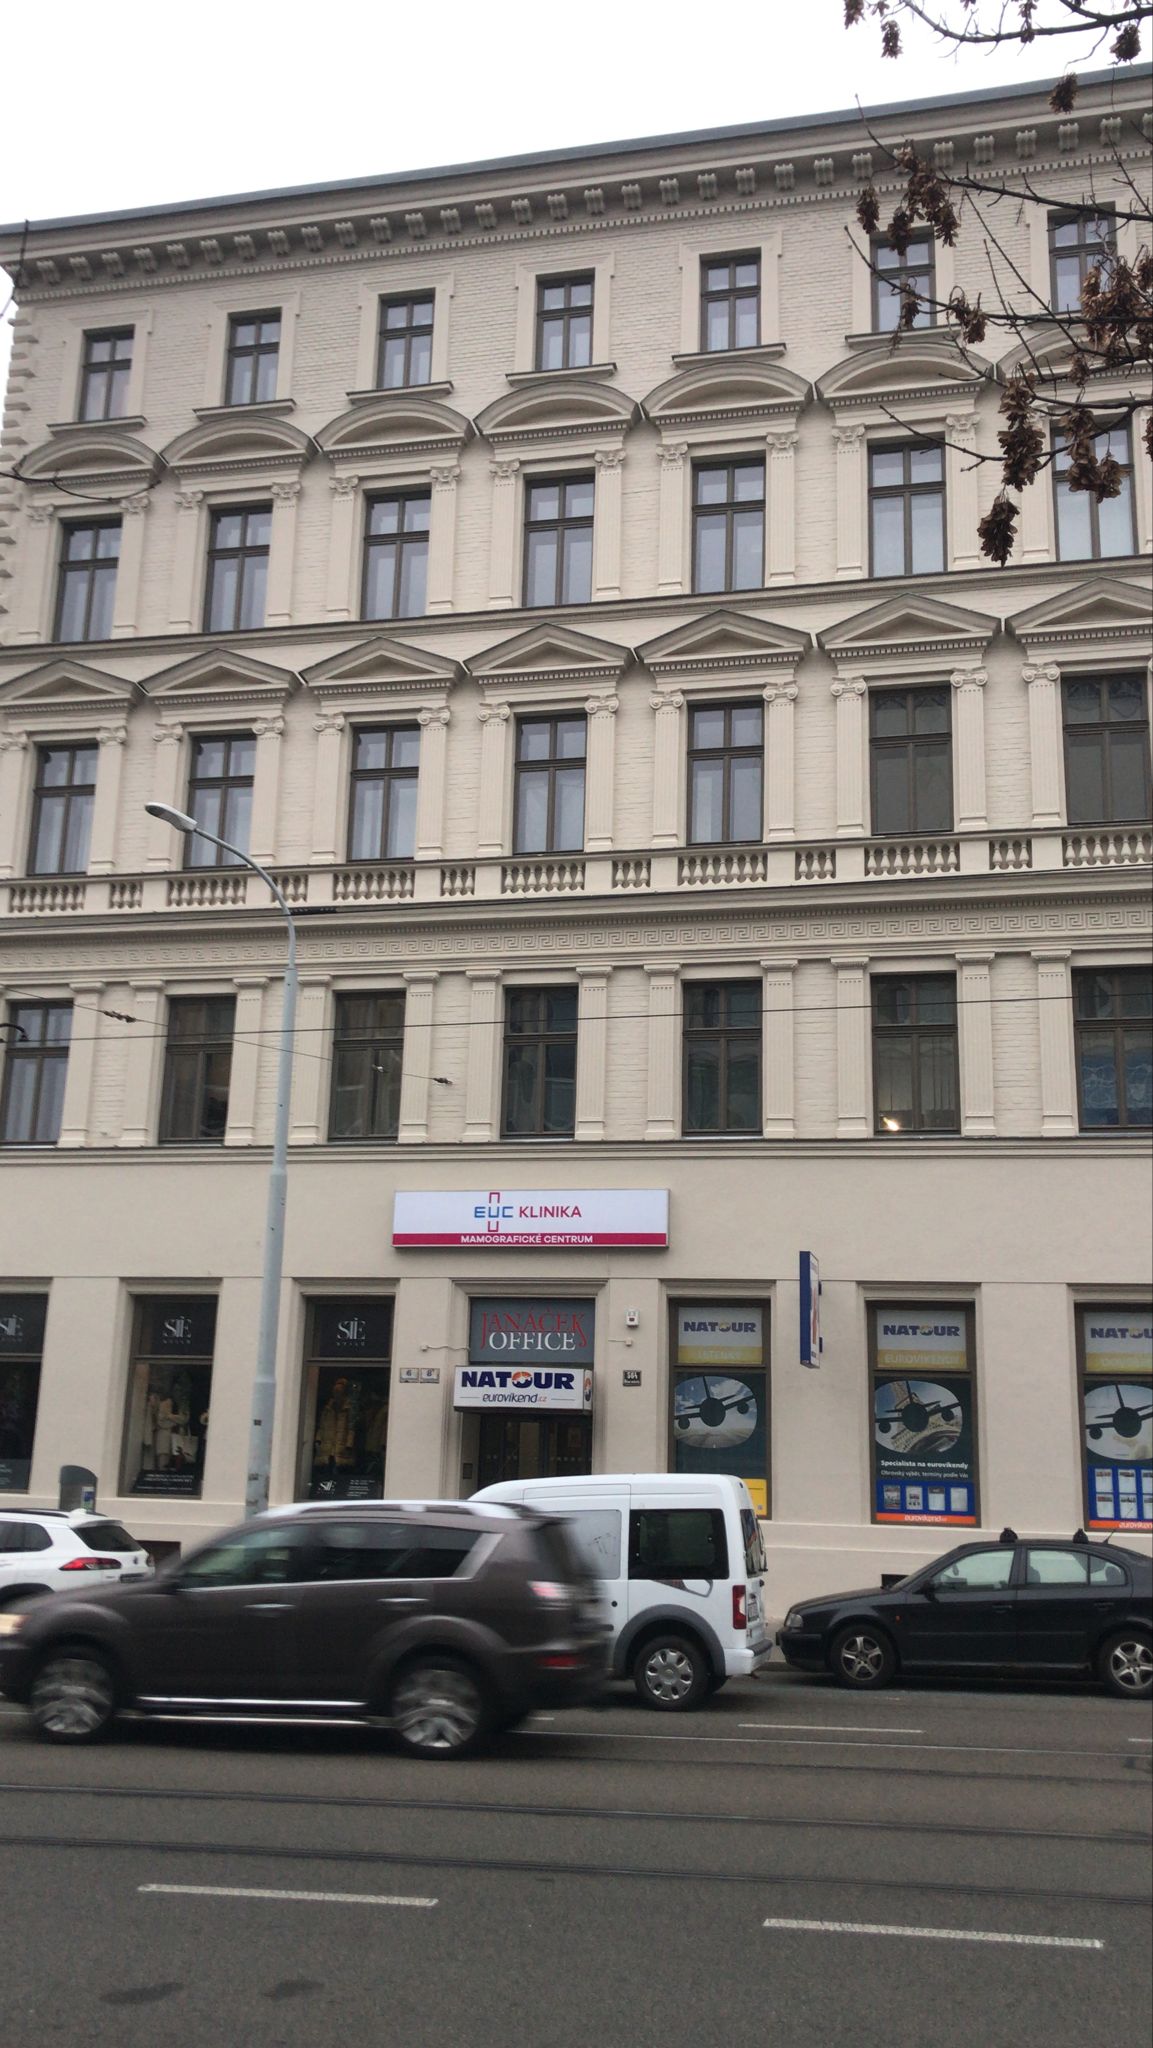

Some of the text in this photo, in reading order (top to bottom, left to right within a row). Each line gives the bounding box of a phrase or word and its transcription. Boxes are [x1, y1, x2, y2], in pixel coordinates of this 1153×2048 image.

[474, 1206, 582, 1218] EUC KLINIKA
[460, 1233, 593, 1244] MAMOGRAFICKÉ CENTRUM
[683, 1321, 757, 1333] NATOUR
[883, 1324, 960, 1337] NATOUR
[489, 1332, 576, 1351] OFFICE
[461, 1371, 575, 1390] NATOUR
[881, 1460, 916, 1469] Specialista
